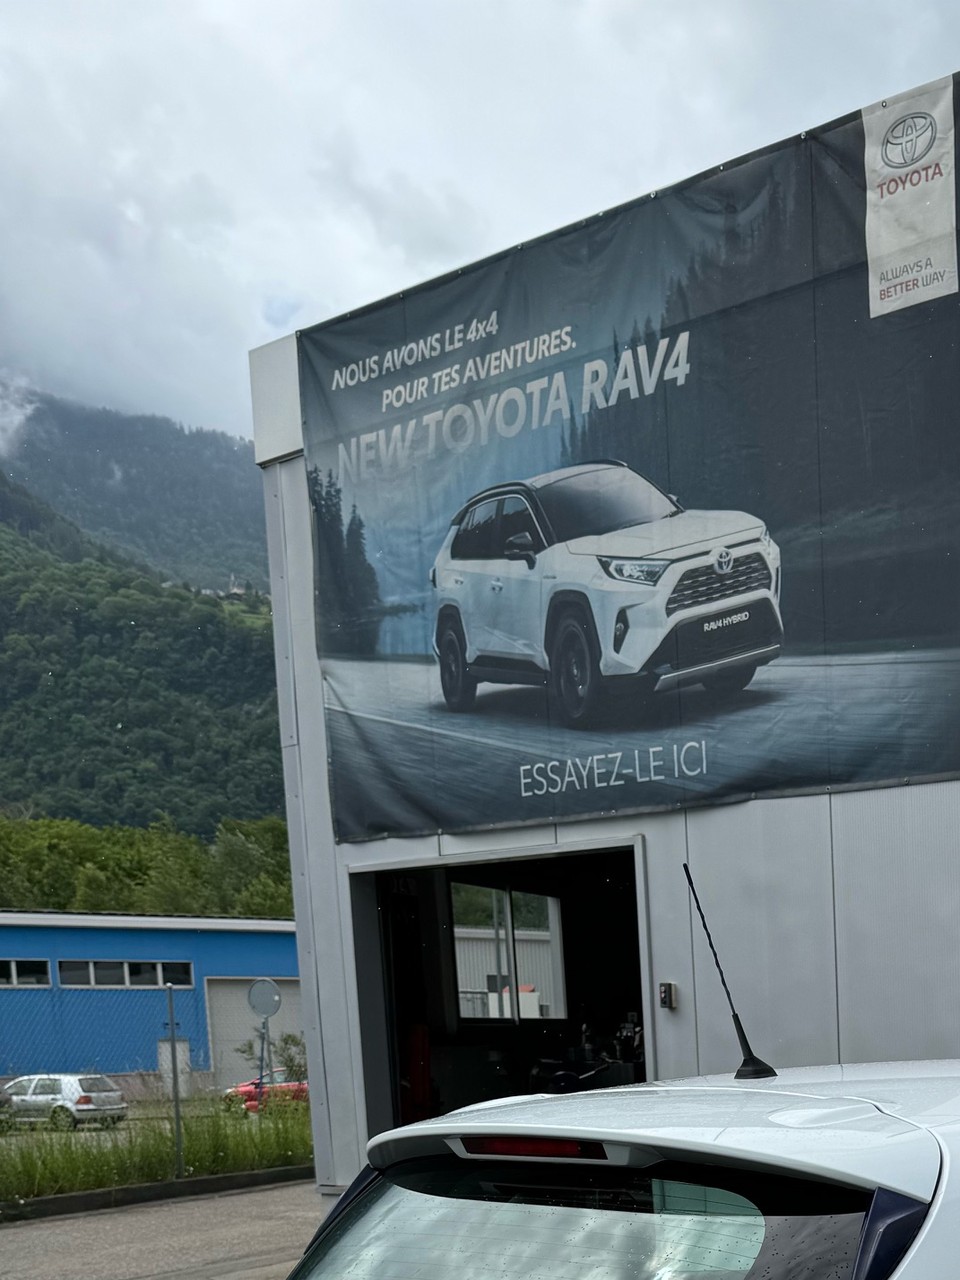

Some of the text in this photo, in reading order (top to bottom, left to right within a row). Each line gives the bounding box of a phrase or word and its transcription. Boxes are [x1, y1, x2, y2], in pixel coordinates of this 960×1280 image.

[877, 163, 944, 199] TOYOTA
[879, 257, 934, 285] ALWAYS A
[879, 269, 947, 300] BETTER WAY
[331, 310, 499, 391] NOUS AVONS LE 4x4
[381, 326, 577, 413] POUR TES AVENTURES.
[337, 331, 691, 485] NEW TOYOTA RAV4
[703, 611, 750, 632] RAV4 HYBRID
[519, 740, 708, 797] ESSAYEZ-LE ICI
